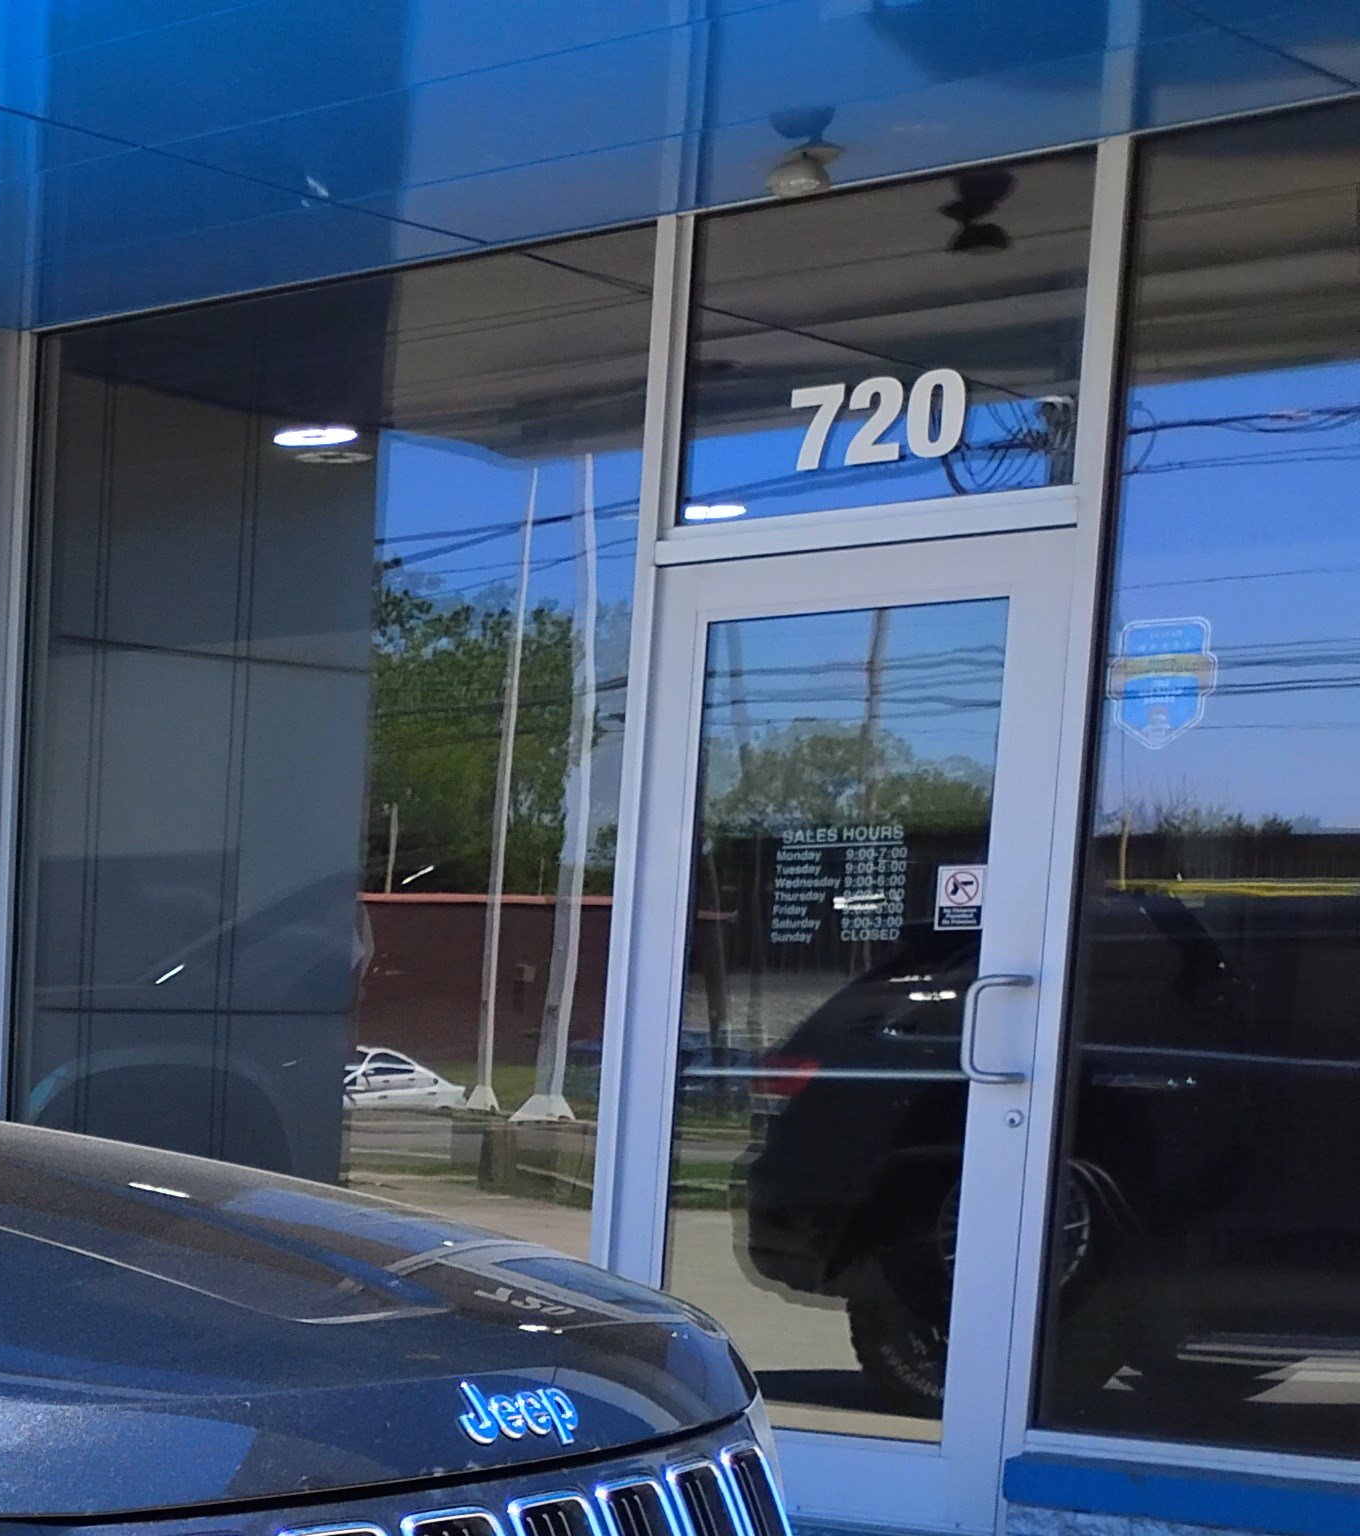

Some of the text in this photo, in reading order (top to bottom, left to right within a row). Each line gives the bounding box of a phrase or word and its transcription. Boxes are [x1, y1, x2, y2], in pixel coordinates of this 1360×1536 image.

[790, 368, 967, 472] 720
[781, 825, 905, 844] SALES HOURS
[775, 850, 822, 862] Monday
[775, 864, 822, 876] Tuesday
[774, 877, 842, 889] Wednesday
[773, 890, 826, 903] Thursday
[772, 905, 809, 917] Friday
[771, 917, 822, 930] Saturday
[770, 929, 900, 943] Sunday CLOSED
[457, 1381, 579, 1445] Jeep
